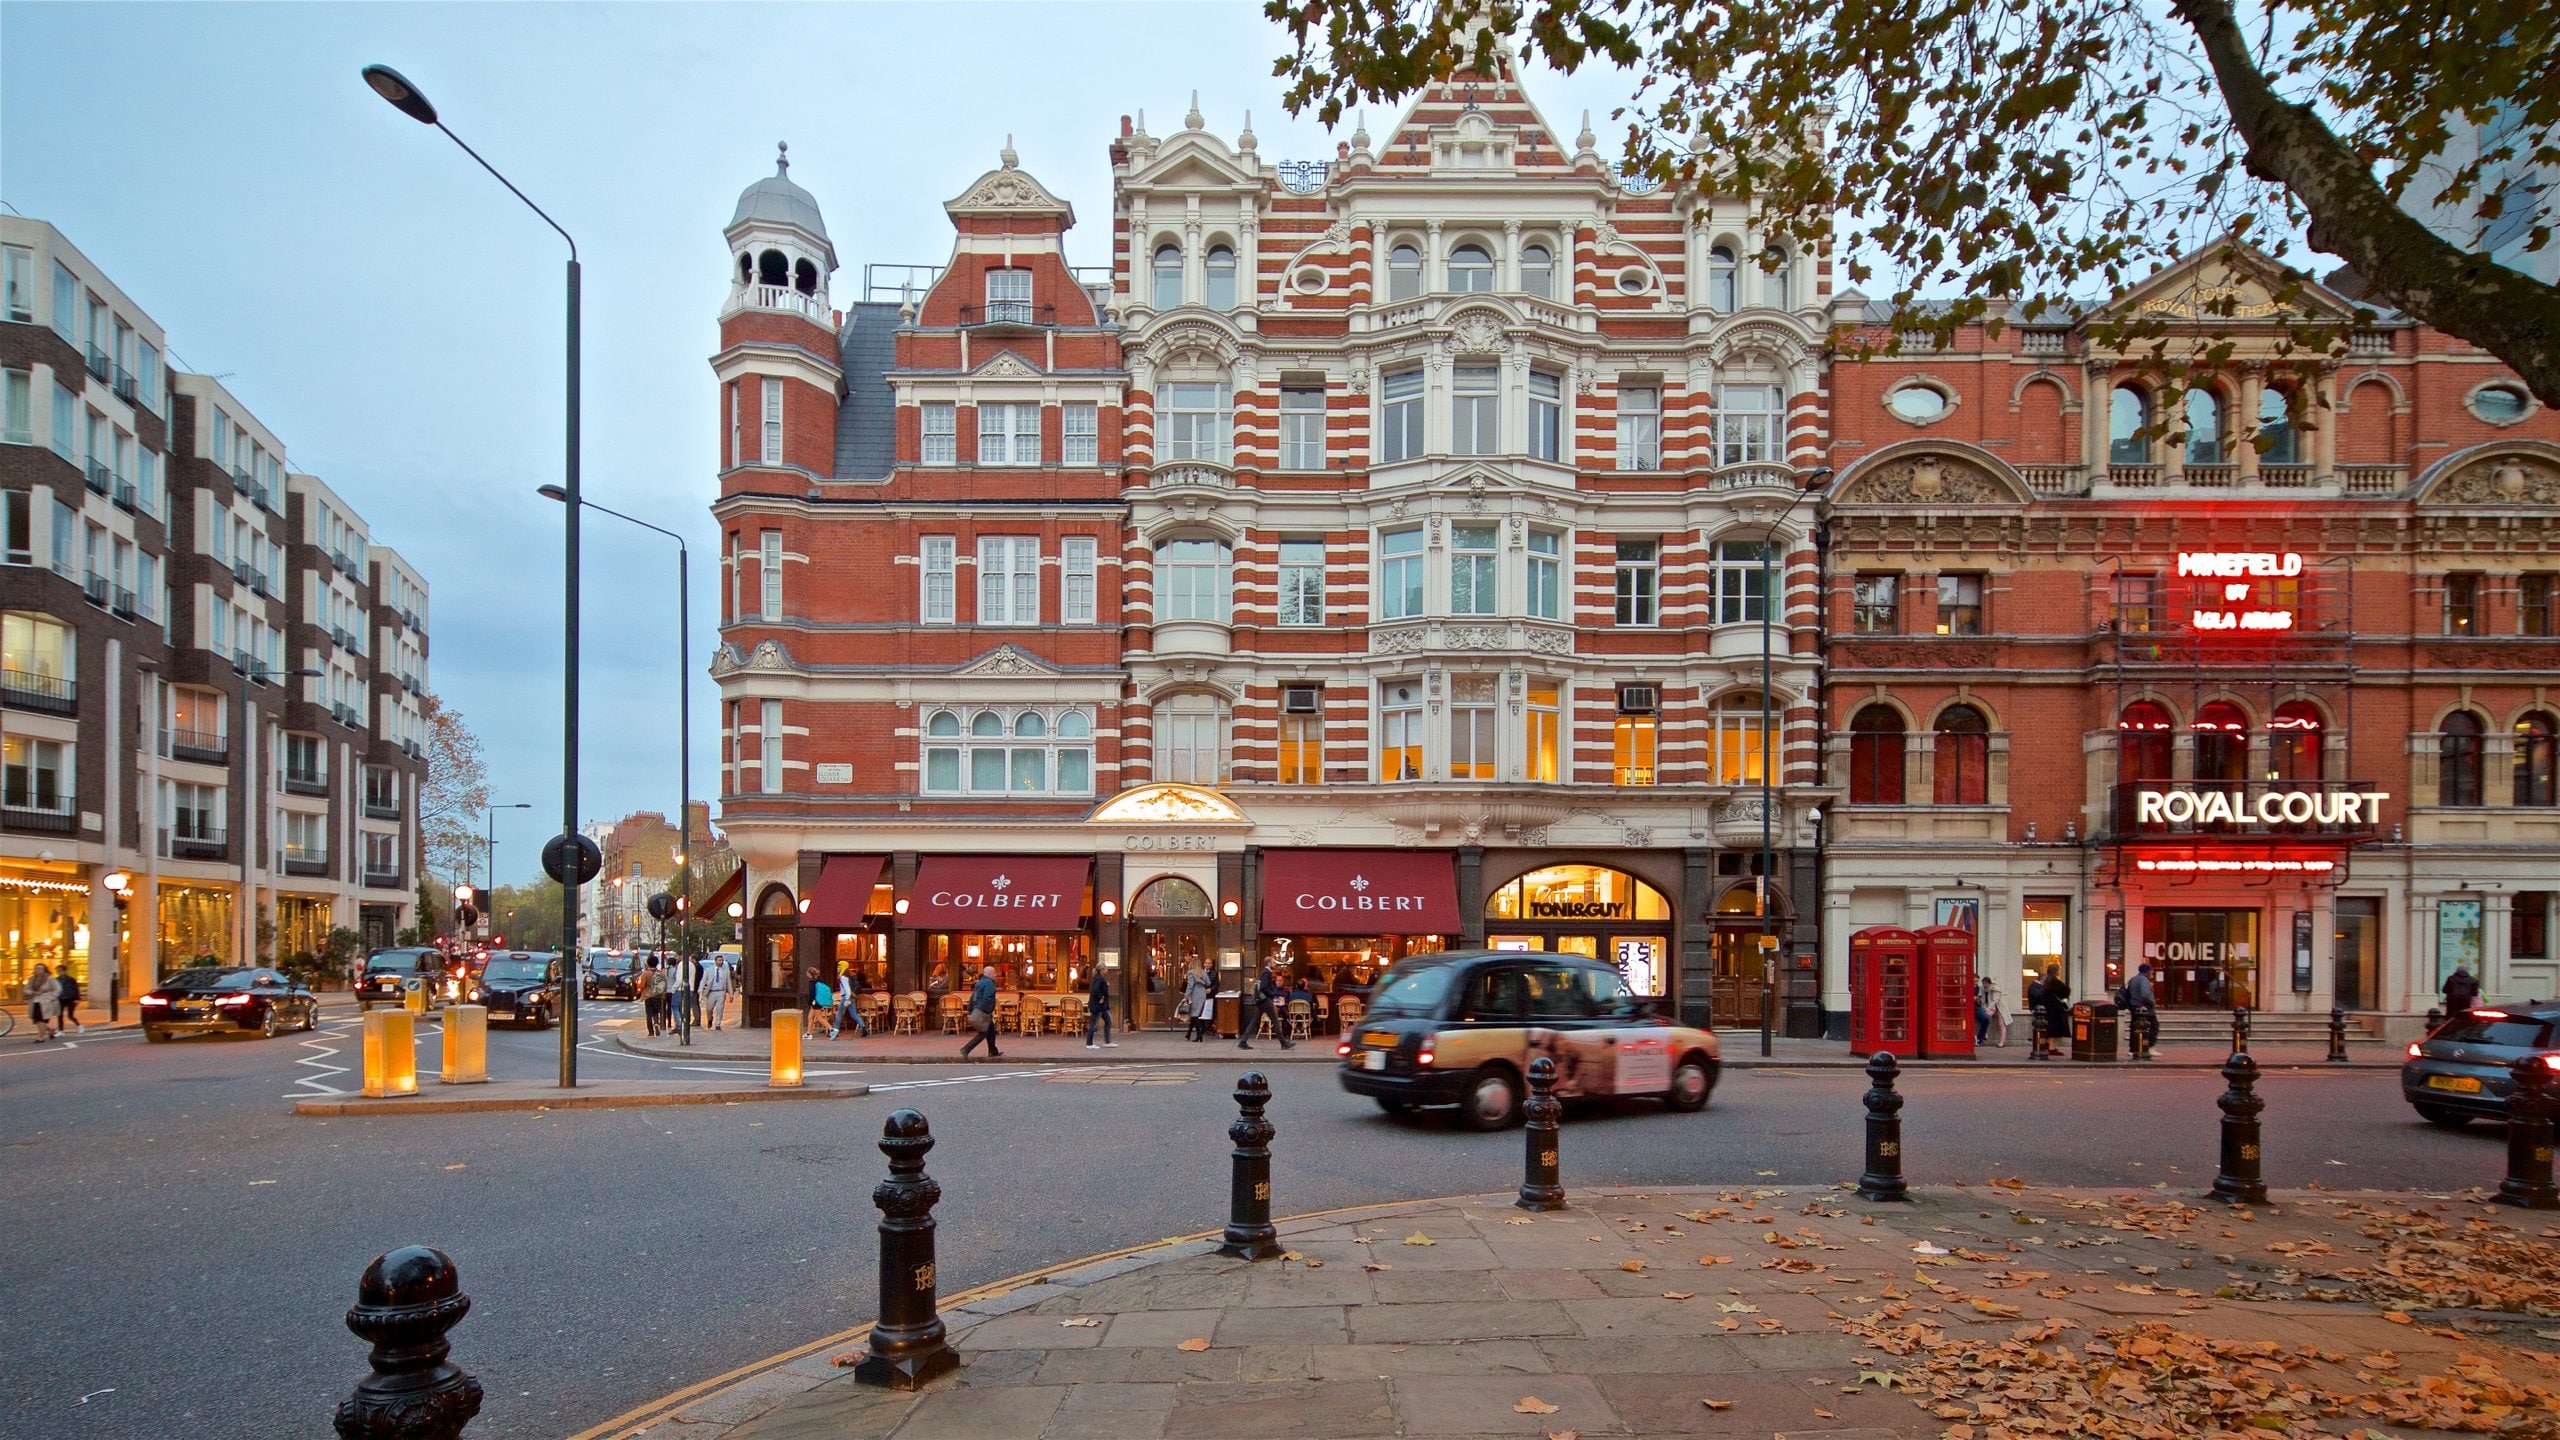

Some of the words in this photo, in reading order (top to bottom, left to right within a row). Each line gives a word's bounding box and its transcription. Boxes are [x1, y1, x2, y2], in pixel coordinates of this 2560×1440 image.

[2139, 790, 2258, 823] ROYAL
[2258, 790, 2390, 824] COURT
[1125, 835, 1217, 850] COLBERT
[931, 891, 1062, 908] COLBERT
[1295, 893, 1425, 910] COLBERT
[1531, 902, 1625, 917] TONI&GUY
[2155, 942, 2215, 961] COME
[2220, 942, 2240, 960] IN
